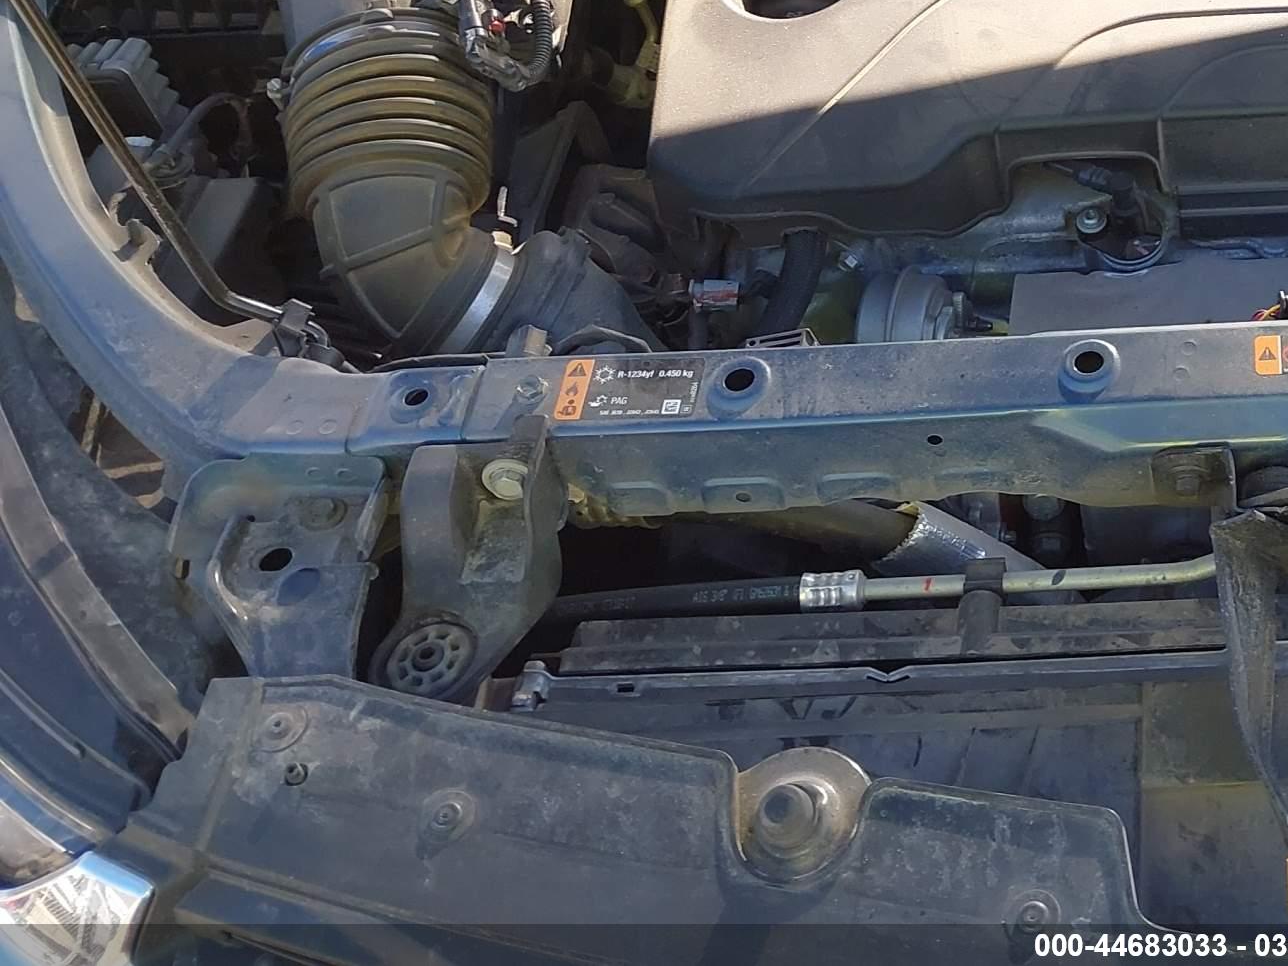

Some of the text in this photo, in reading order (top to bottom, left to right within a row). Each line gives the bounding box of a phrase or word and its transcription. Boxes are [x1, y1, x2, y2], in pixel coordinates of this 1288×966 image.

[617, 369, 694, 379] R-1234yf 0.450 kg
[610, 396, 628, 405] PAG
